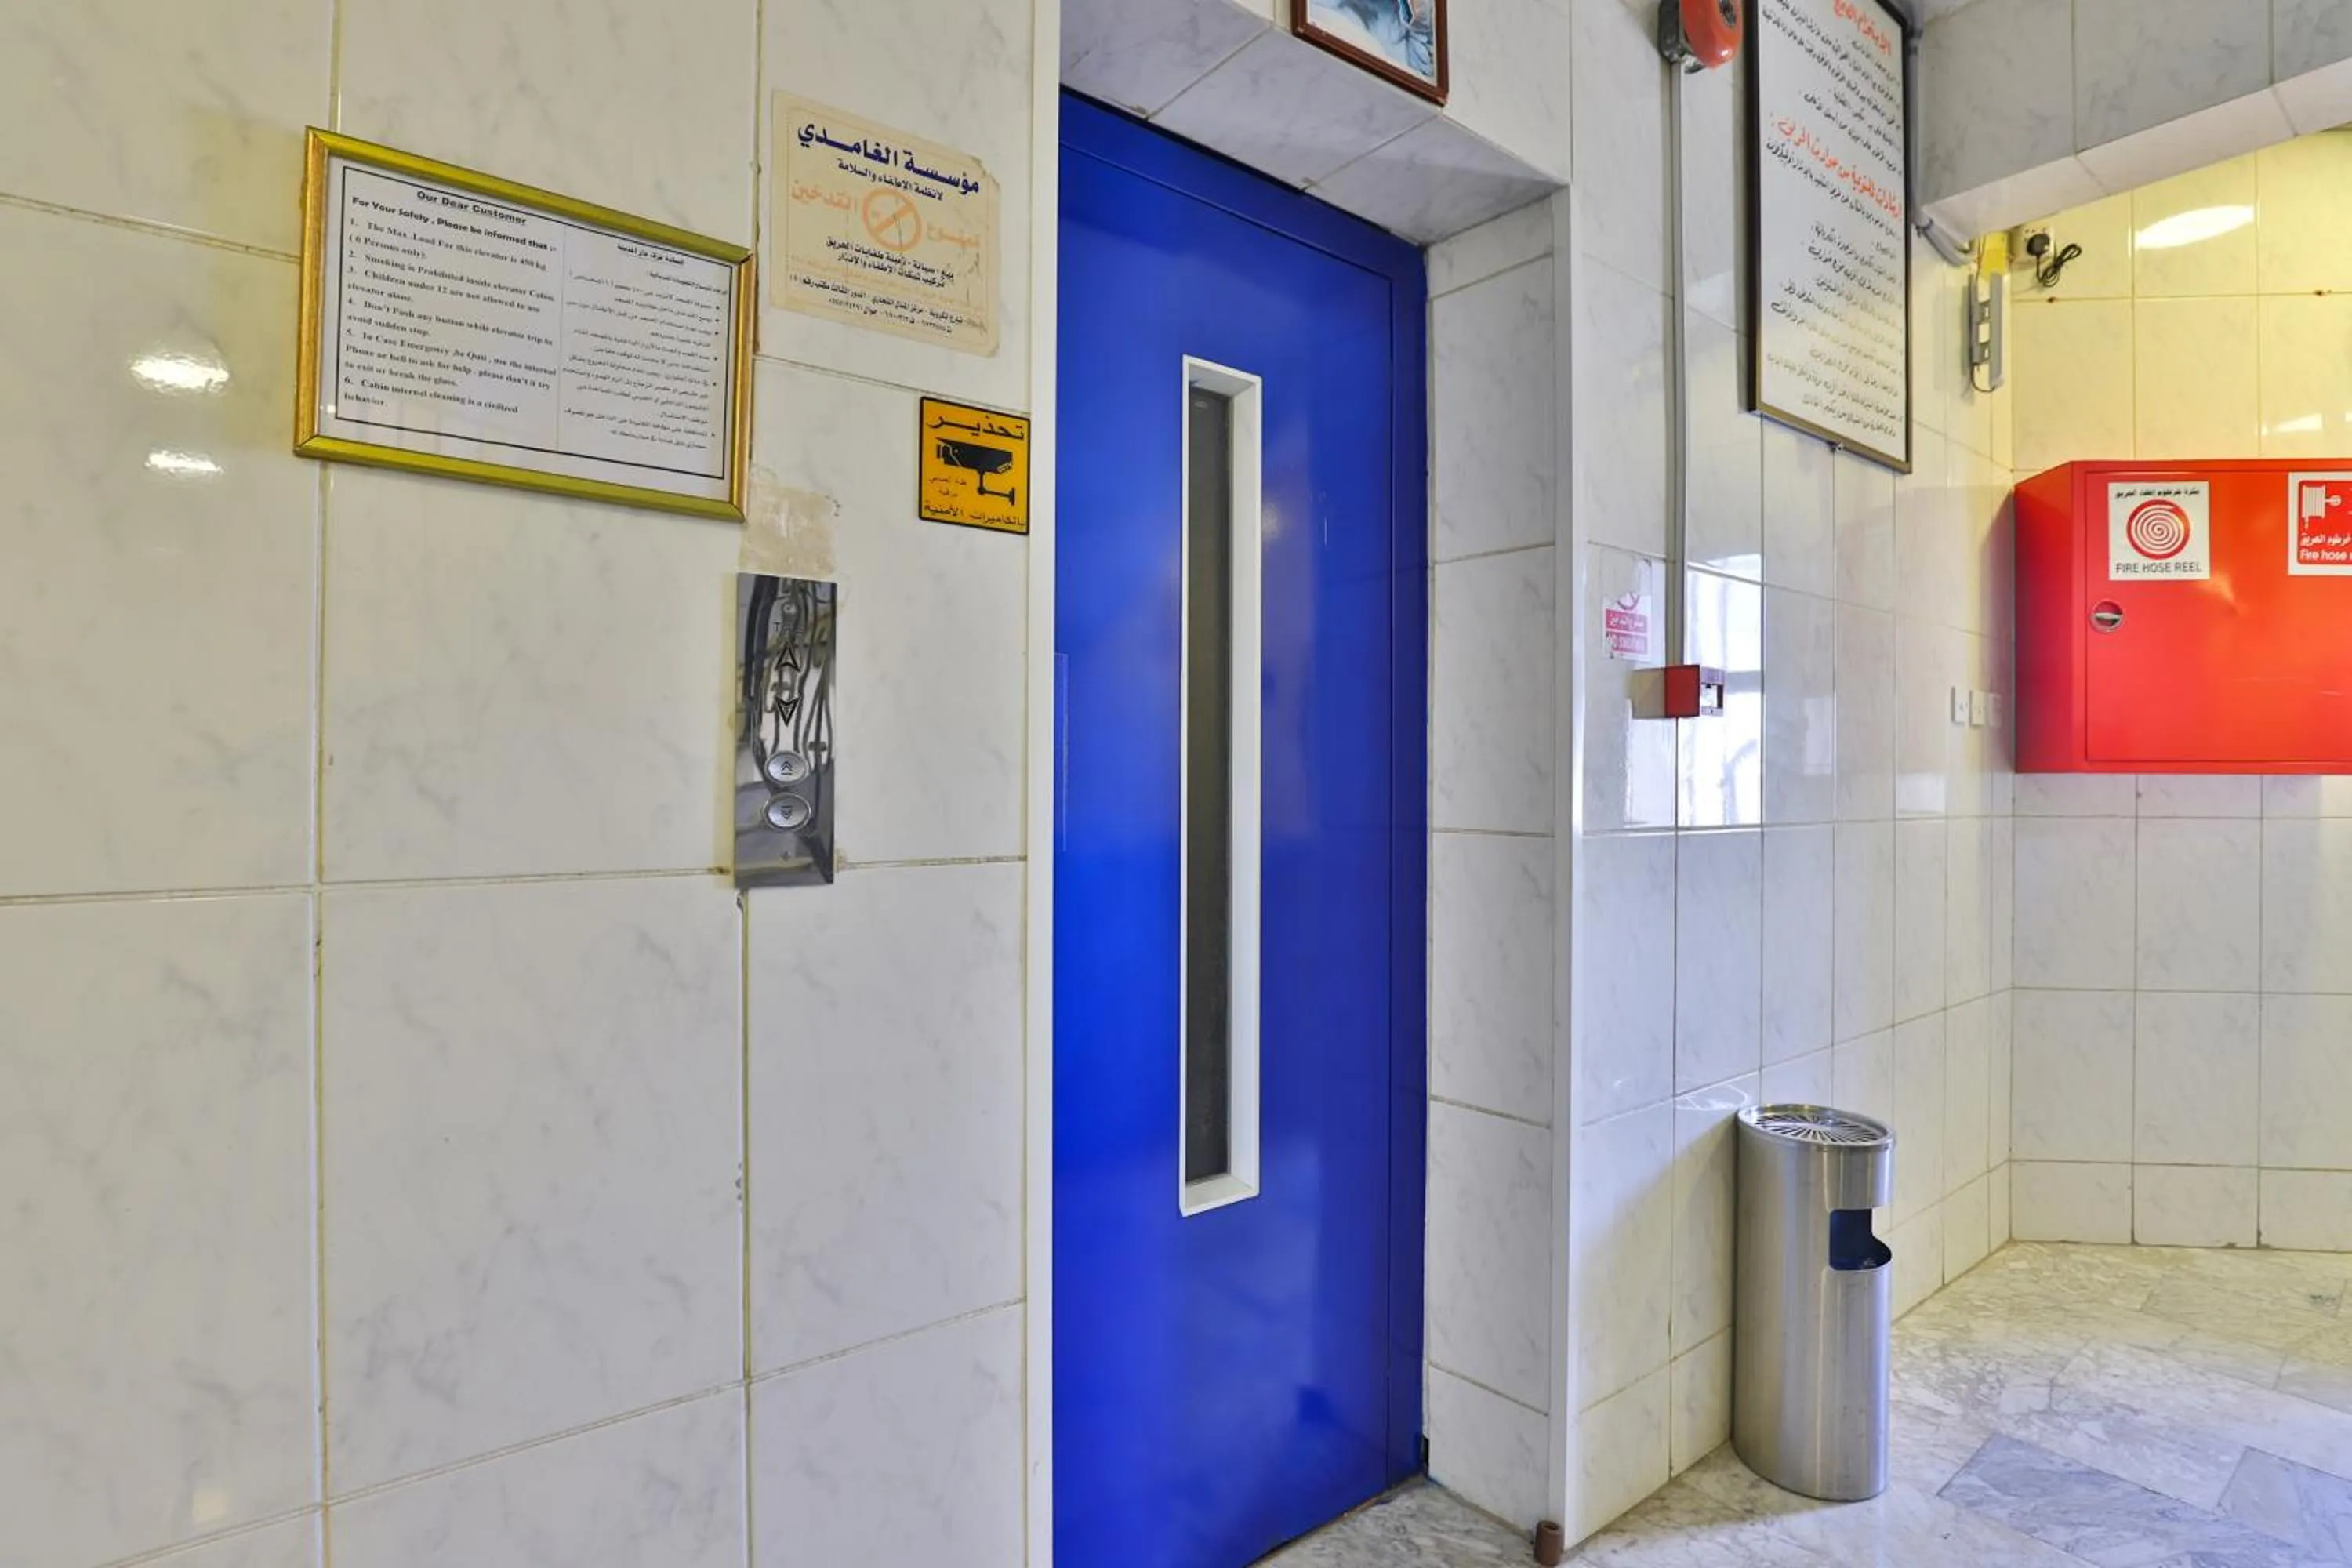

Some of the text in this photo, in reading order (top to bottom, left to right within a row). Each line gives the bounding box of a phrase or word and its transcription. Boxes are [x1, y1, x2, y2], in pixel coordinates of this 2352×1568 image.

[798, 124, 979, 195] مؤسسة الغامدي
[417, 191, 527, 223] Our Dear Customer
[352, 197, 369, 207] For
[372, 201, 396, 213] Your
[470, 226, 482, 235] be
[485, 229, 526, 245] informed
[528, 240, 547, 250] that
[368, 222, 384, 232] The
[365, 270, 405, 285] Children
[927, 414, 1024, 440] تحذير
[2299, 549, 2320, 560] Fire
[2321, 549, 2347, 561] hose
[2114, 561, 2202, 573] FIRE HOSE REEL
